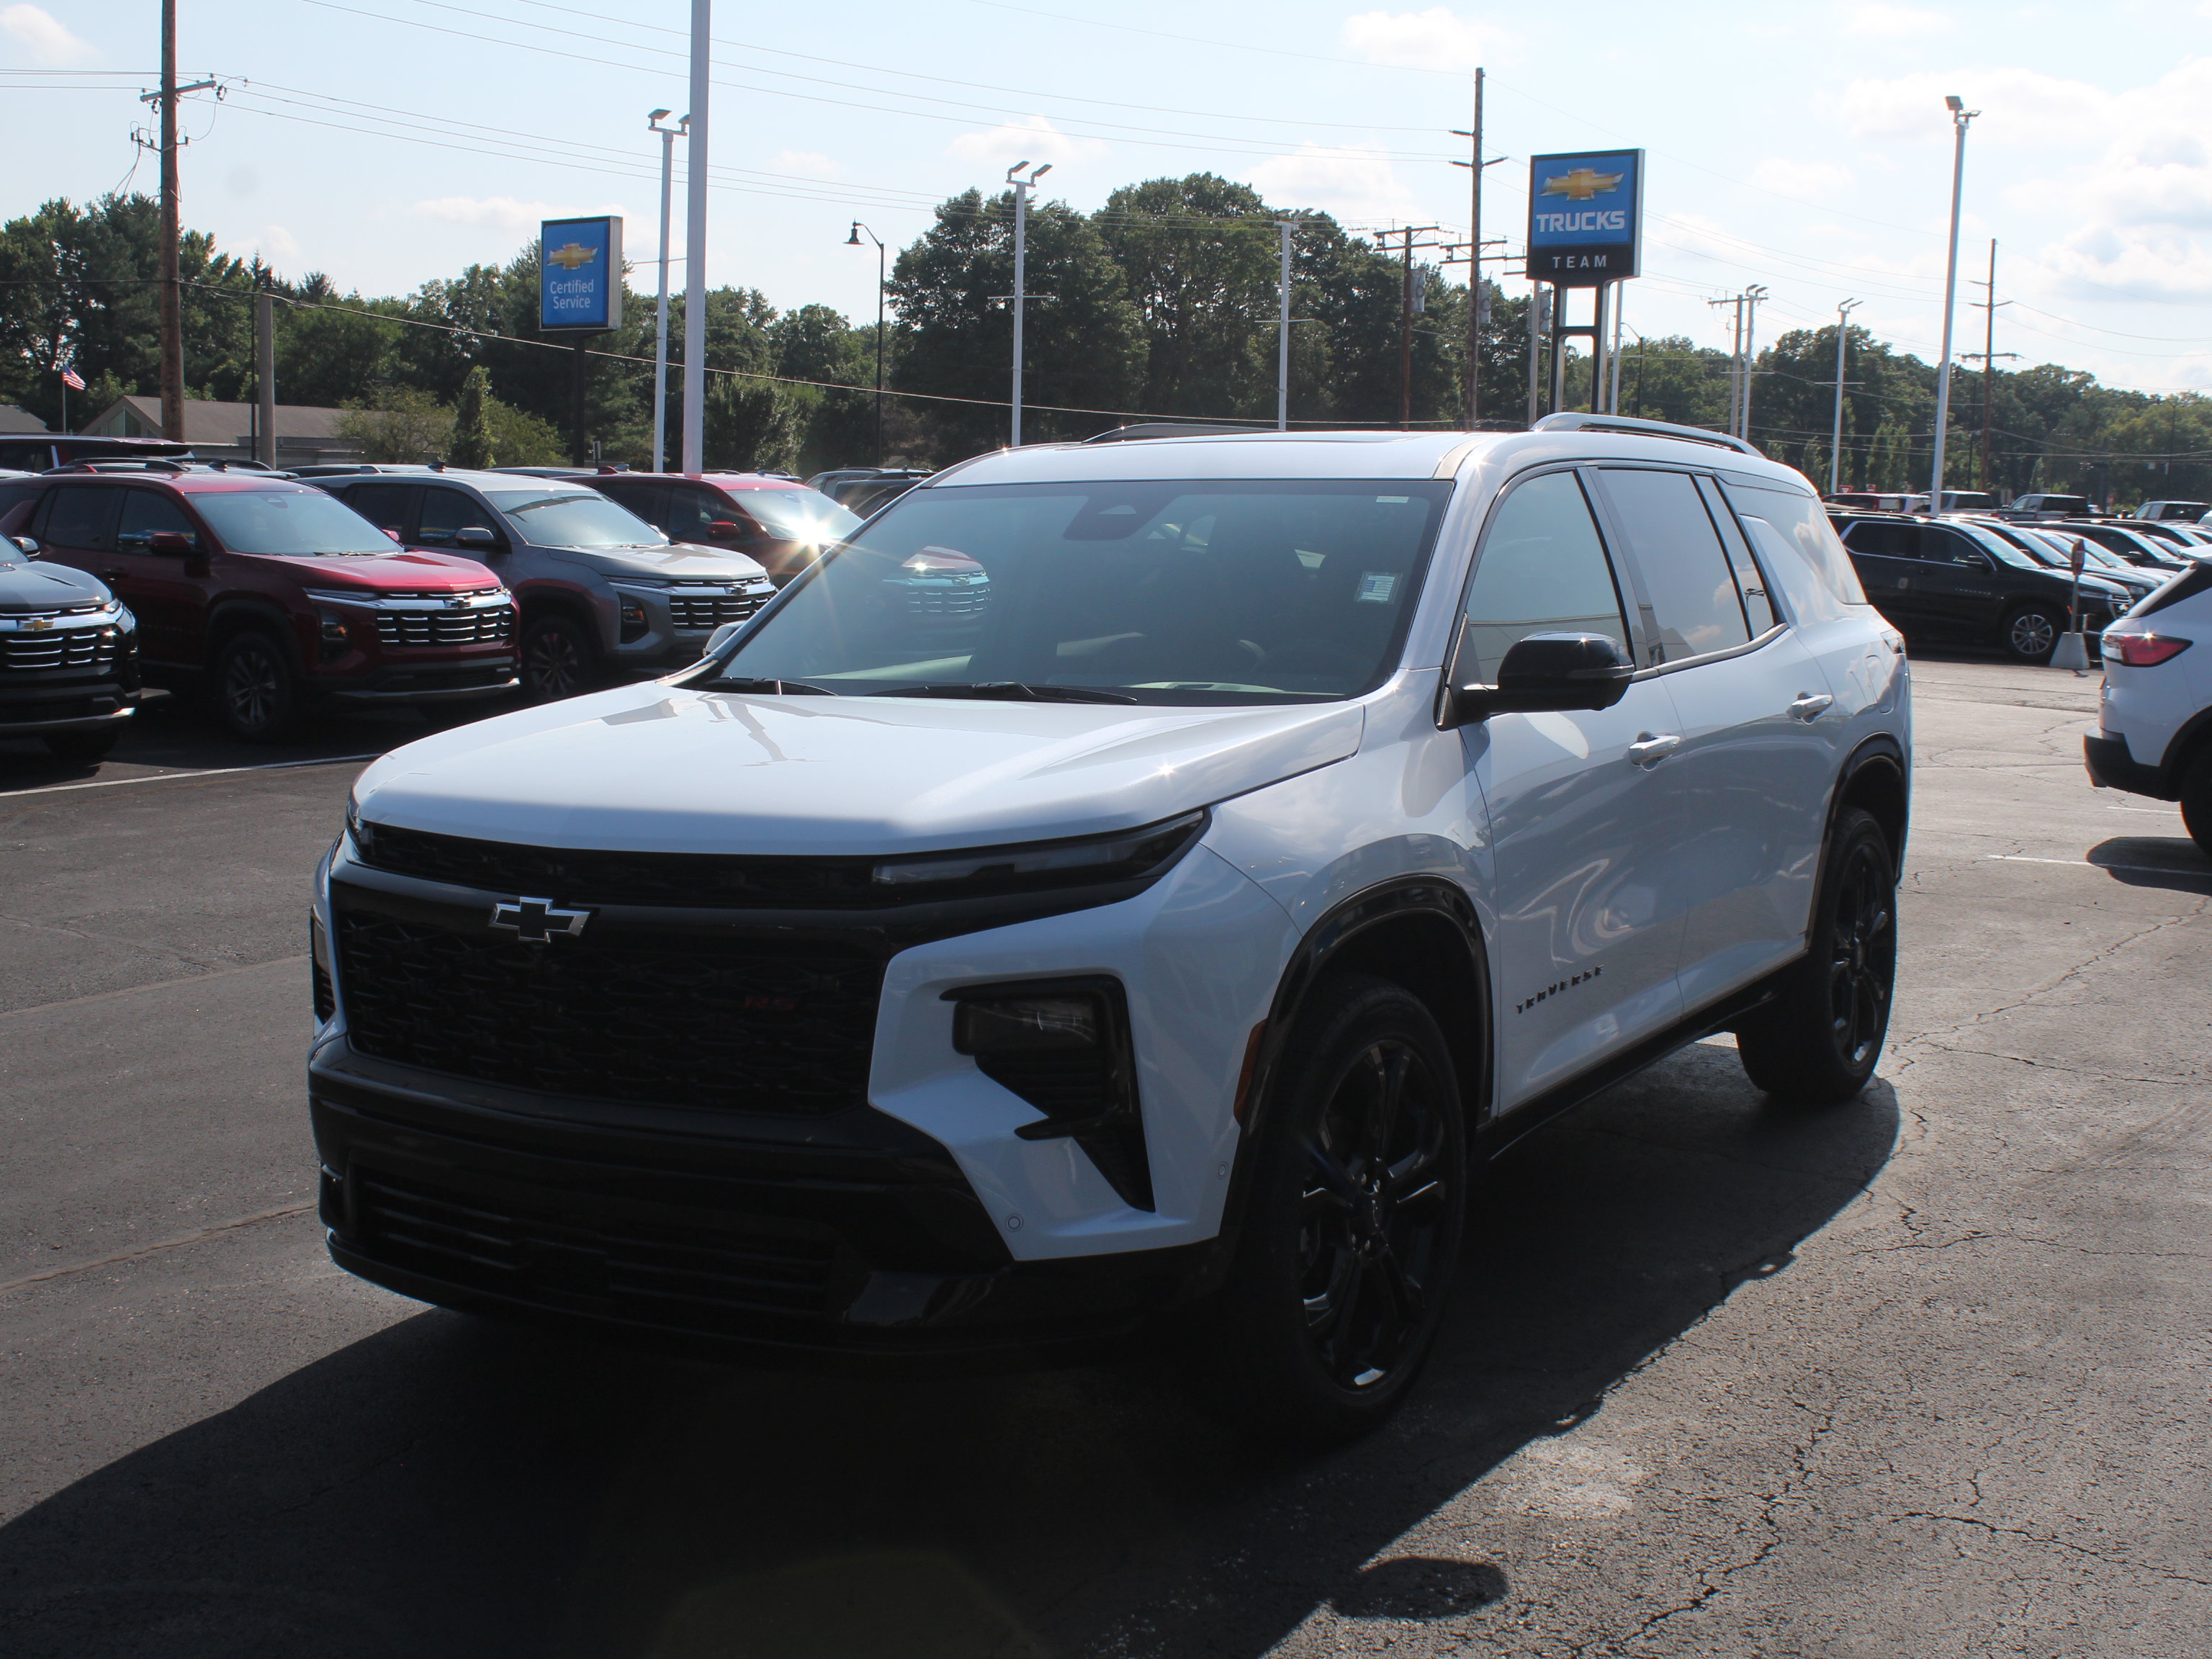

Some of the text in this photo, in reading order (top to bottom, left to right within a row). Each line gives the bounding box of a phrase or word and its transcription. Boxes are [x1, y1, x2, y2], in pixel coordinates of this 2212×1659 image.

[1536, 211, 1625, 233] TRUCKS
[1552, 255, 1606, 269] TEAM
[550, 279, 594, 295] Certified
[553, 295, 590, 309] Service
[1516, 964, 1604, 1014] TRAVERSE
